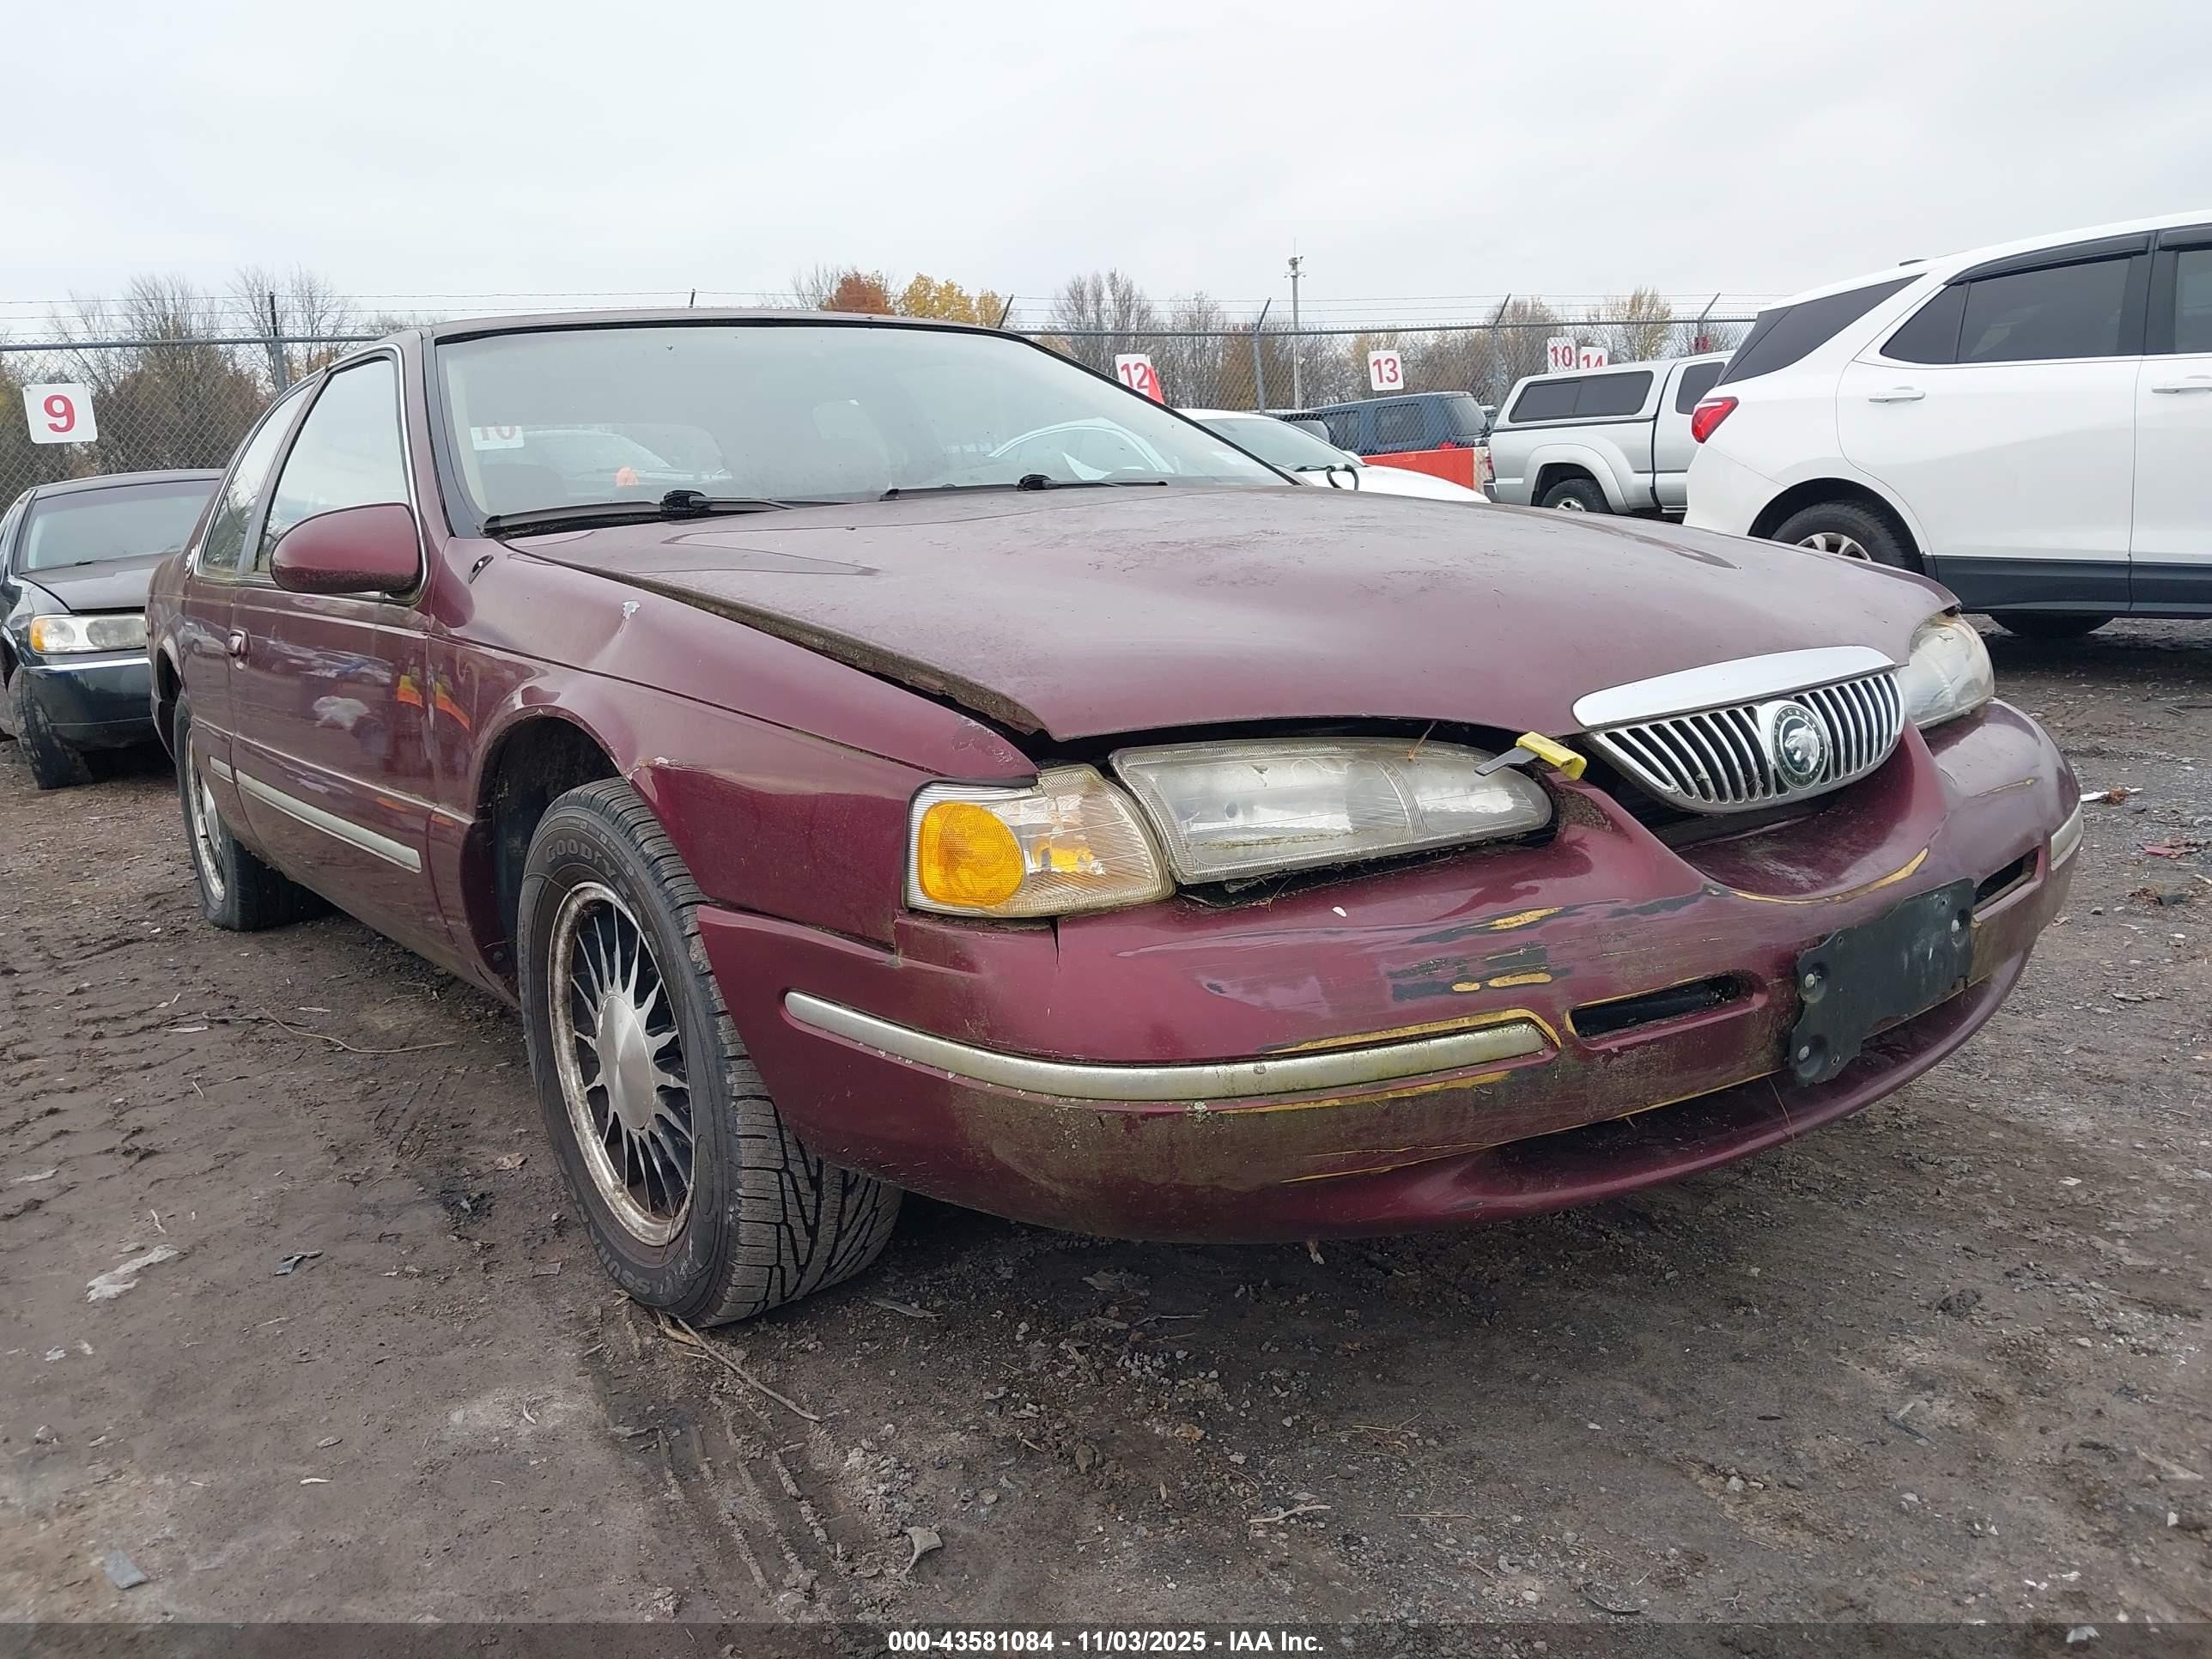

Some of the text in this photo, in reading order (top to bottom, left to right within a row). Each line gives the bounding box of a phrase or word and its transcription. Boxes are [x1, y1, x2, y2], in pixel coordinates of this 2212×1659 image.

[1551, 346, 1572, 367] 10
[1121, 362, 1148, 389] 12
[1372, 357, 1399, 383] 13
[43, 394, 76, 433] 9
